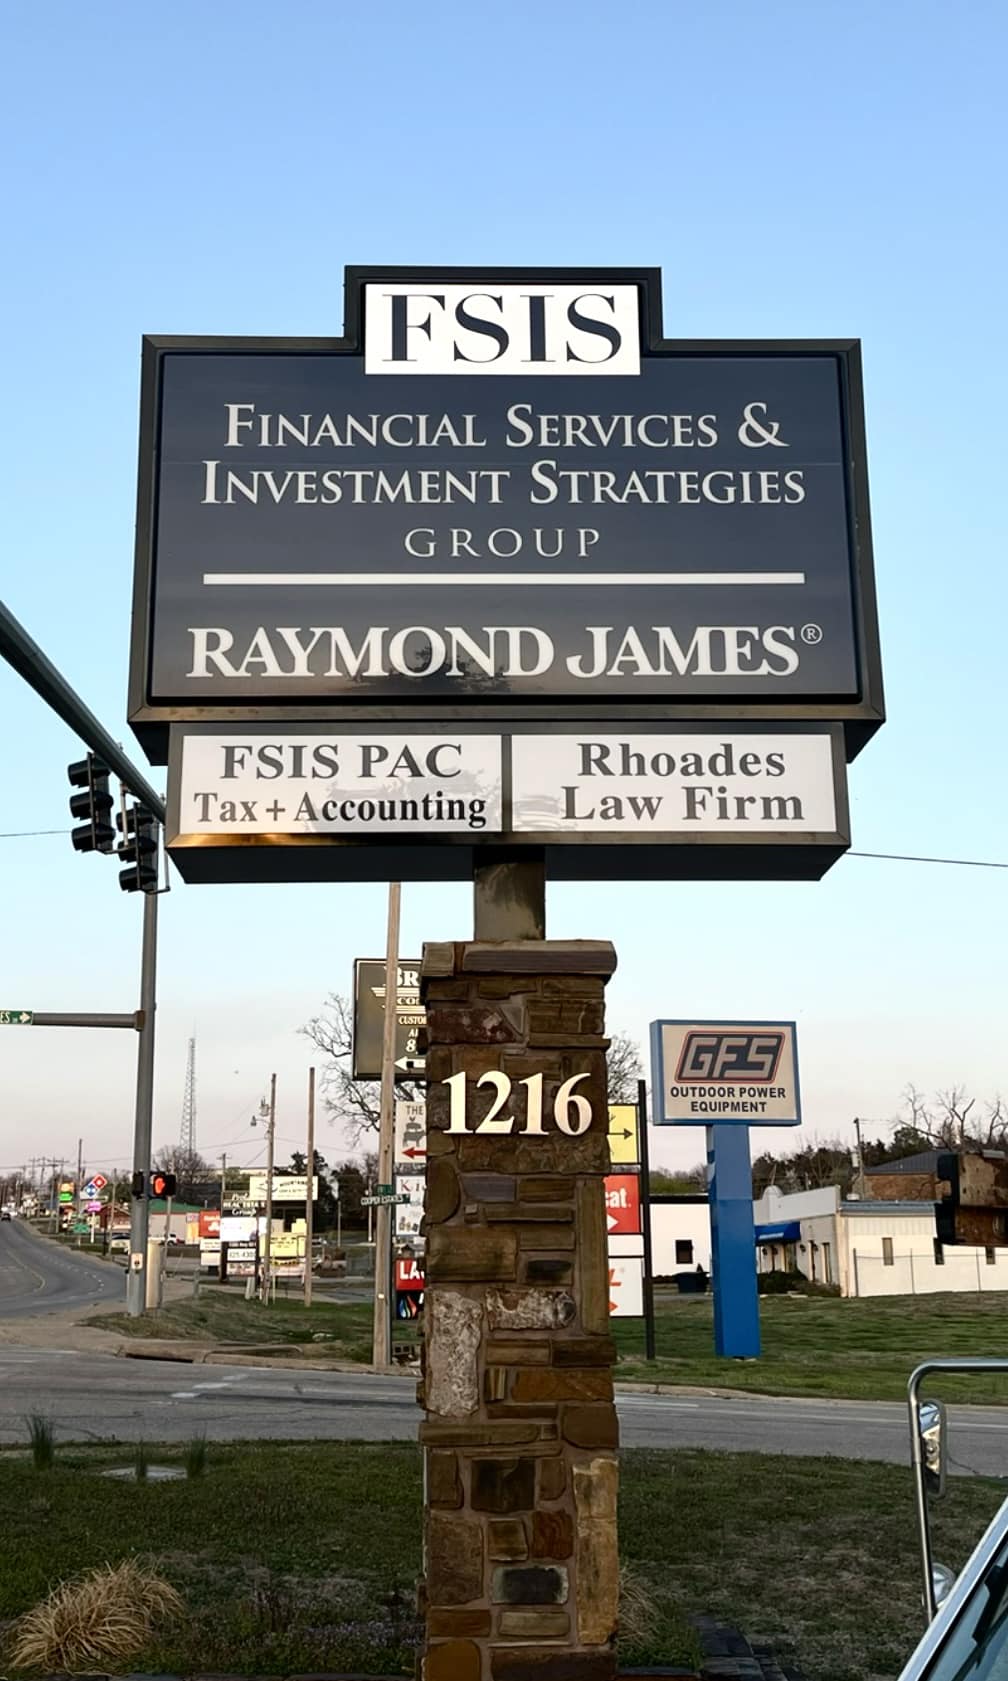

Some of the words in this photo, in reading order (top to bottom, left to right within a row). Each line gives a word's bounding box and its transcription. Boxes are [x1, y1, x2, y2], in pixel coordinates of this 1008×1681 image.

[382, 293, 623, 364] FSIS
[223, 403, 487, 447] FINANCIAL
[506, 403, 718, 448] SERVICES
[738, 402, 790, 448] &
[201, 460, 511, 504] INVESTMENT
[530, 459, 805, 504] STRATEGIES
[404, 528, 600, 558] GROUP
[186, 625, 555, 679] RAYMOND
[220, 744, 340, 780] FSIS
[357, 743, 463, 778] PAC
[577, 742, 786, 778] Rhoades
[561, 786, 663, 822] Law
[681, 785, 805, 822] Firm
[681, 1037, 778, 1078] GFS
[406, 1105, 424, 1116] THE
[442, 1070, 593, 1136] 1216
[670, 1086, 735, 1098] OUTDOOR
[739, 1086, 786, 1098] POWER
[691, 1101, 767, 1113] EQUIPMENT
[400, 1261, 425, 1280] LA
